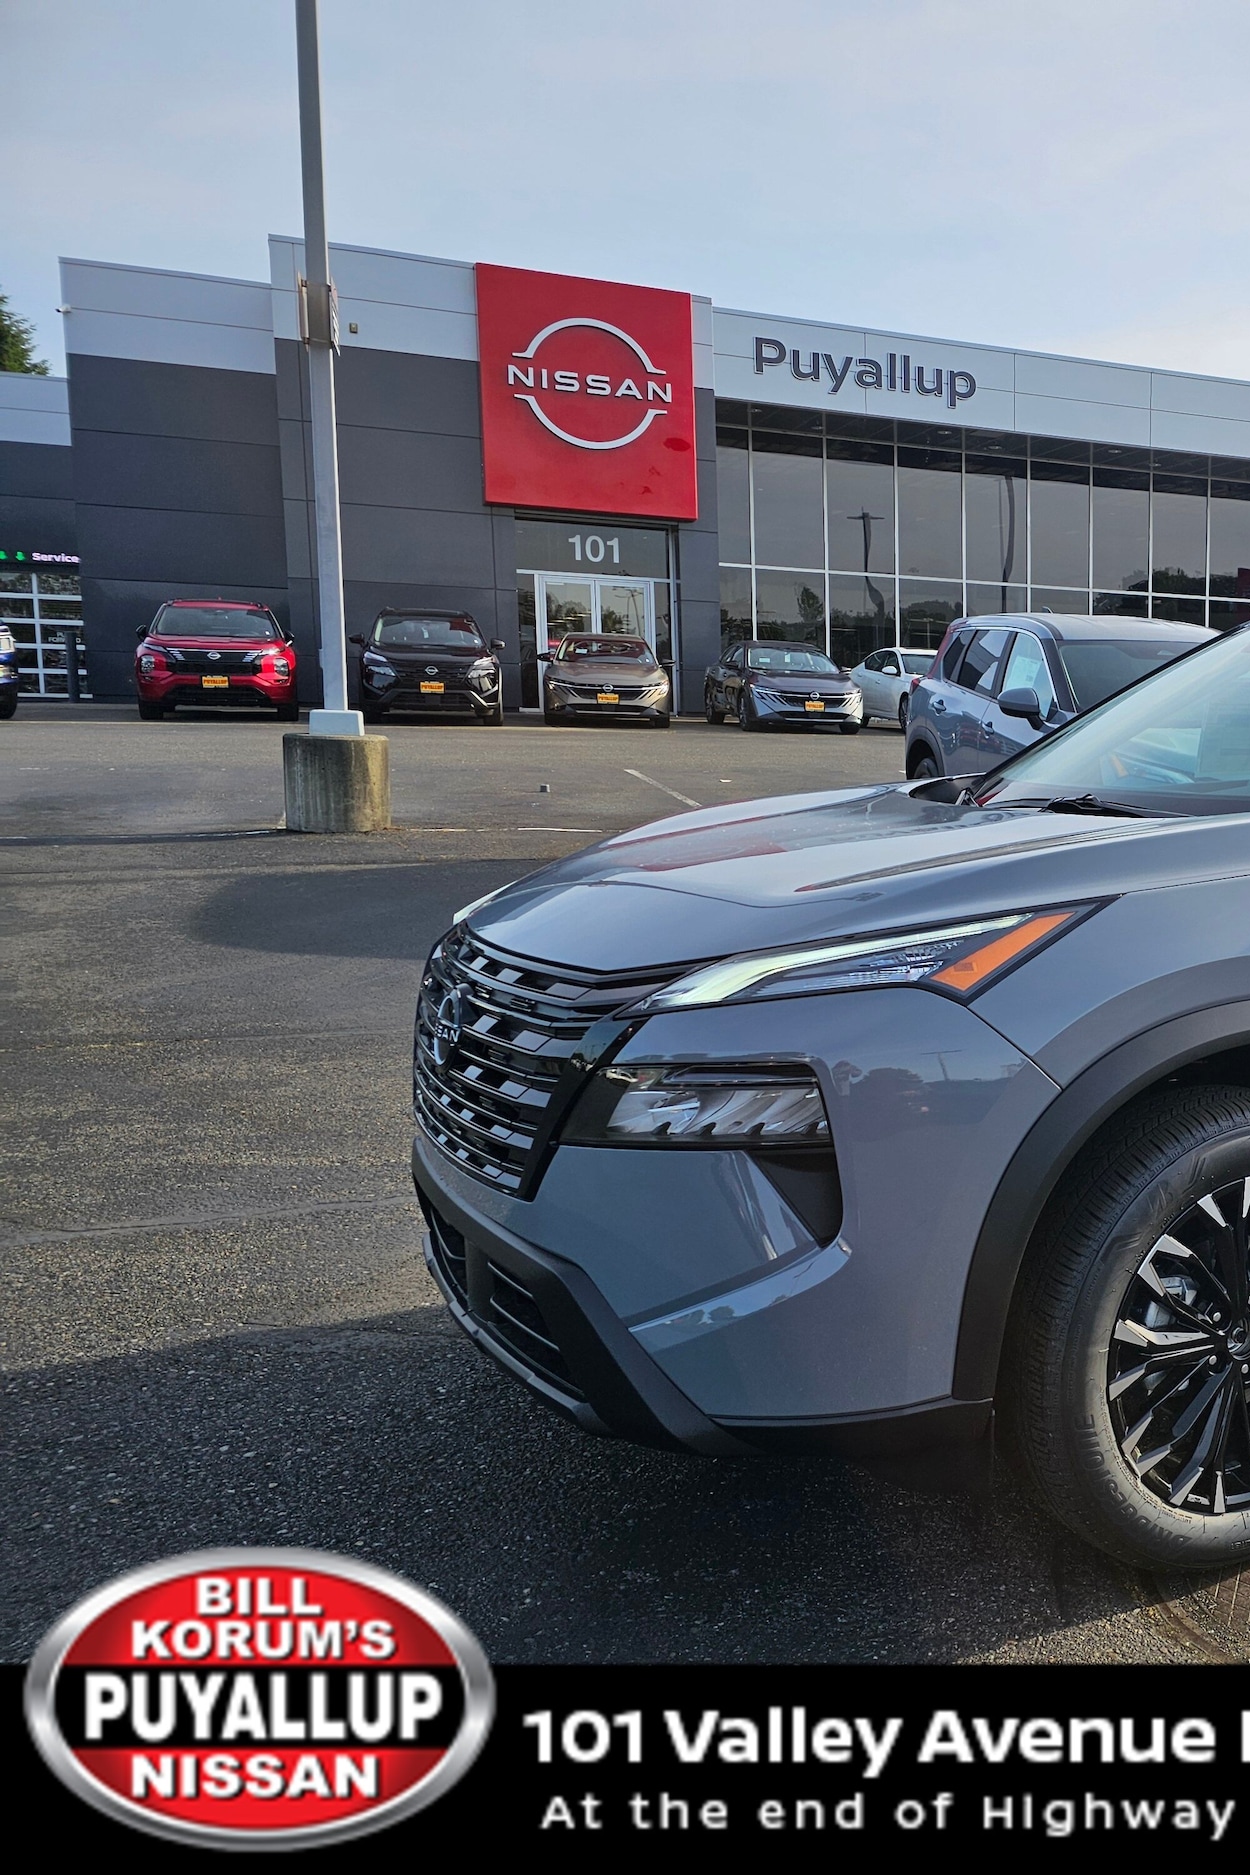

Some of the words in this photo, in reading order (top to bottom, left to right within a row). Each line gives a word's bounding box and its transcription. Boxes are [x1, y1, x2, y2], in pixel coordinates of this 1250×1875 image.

[507, 364, 672, 403] NISSAN
[753, 336, 977, 409] Puyallup
[32, 552, 81, 563] Service
[568, 534, 620, 563] 101
